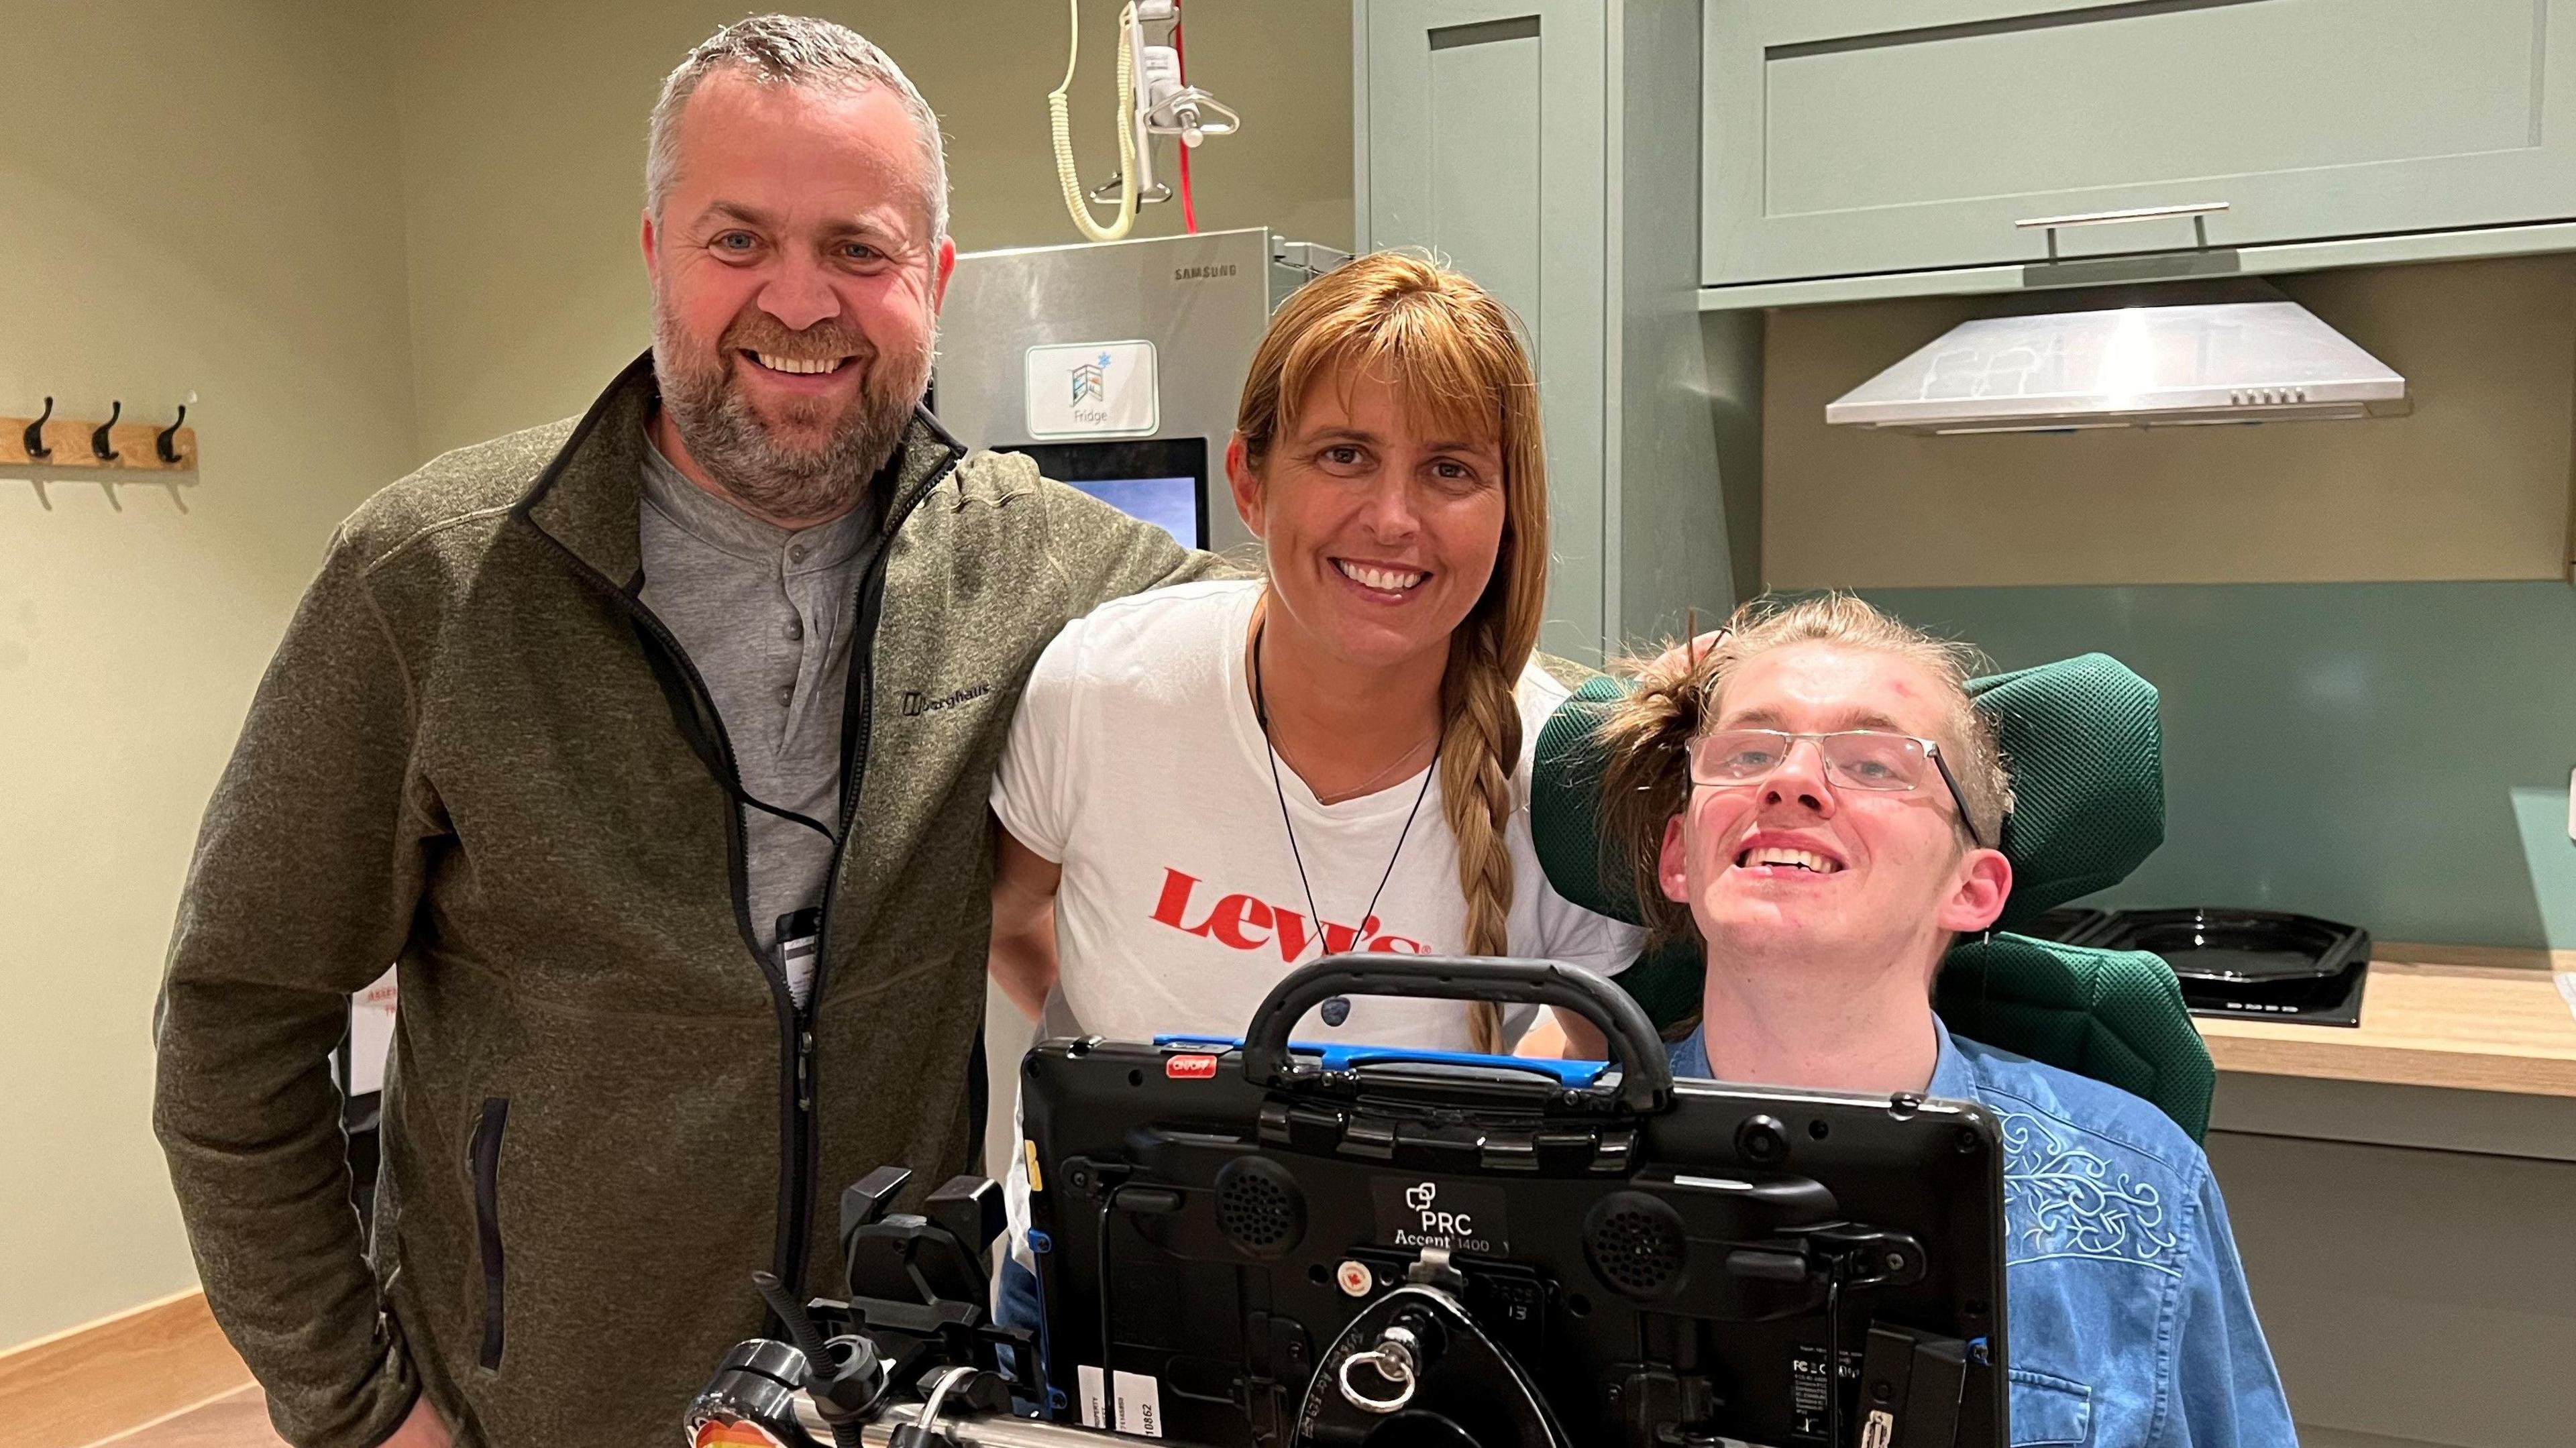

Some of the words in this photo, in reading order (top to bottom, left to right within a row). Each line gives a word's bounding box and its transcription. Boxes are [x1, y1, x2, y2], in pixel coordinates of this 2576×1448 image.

[1175, 264, 1236, 280] SAMSUNG
[1074, 408, 1108, 425] Fridge
[922, 683, 989, 712] berghaus
[1421, 1211, 1473, 1235] PRC
[1395, 1229, 1451, 1249] Accent
[1458, 1237, 1490, 1252] 1400
[1142, 1404, 1155, 1435] 10862
